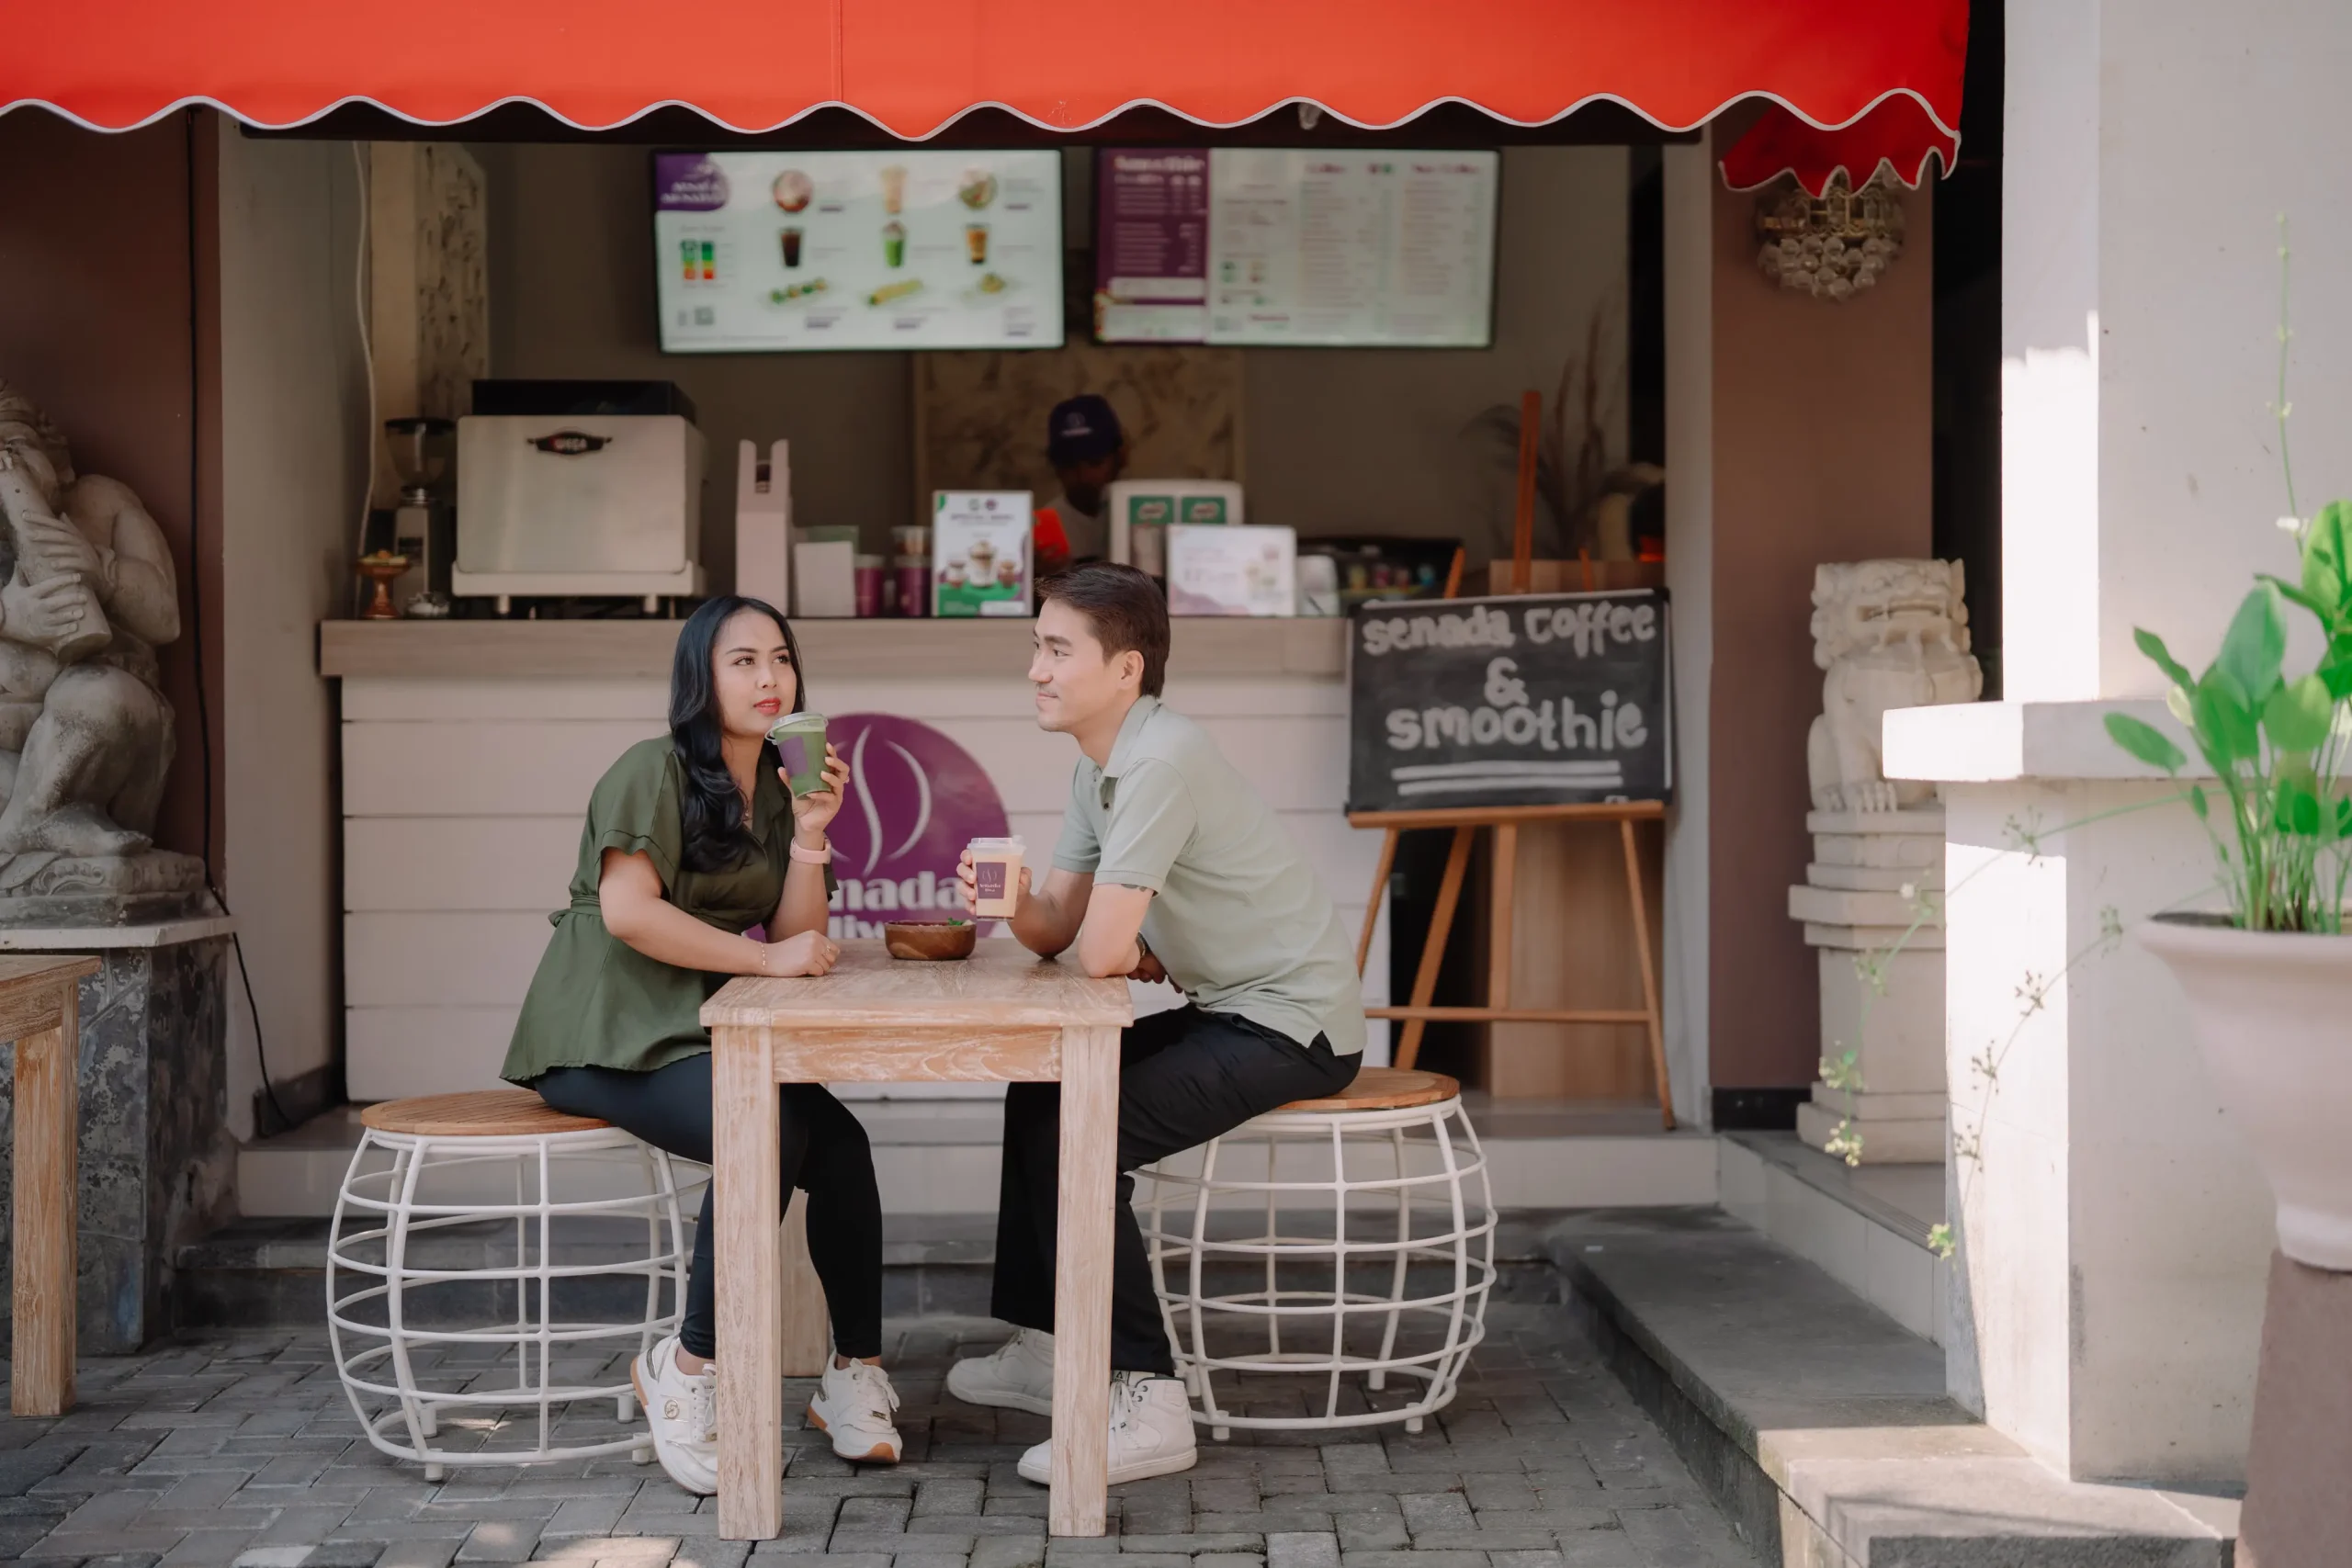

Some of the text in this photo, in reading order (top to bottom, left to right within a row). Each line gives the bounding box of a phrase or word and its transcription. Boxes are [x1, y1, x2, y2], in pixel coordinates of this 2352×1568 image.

[1362, 600, 1656, 658] senada coffee
[1483, 657, 1529, 706] &
[1385, 690, 1647, 751] smoothie
[828, 870, 965, 911] nada
